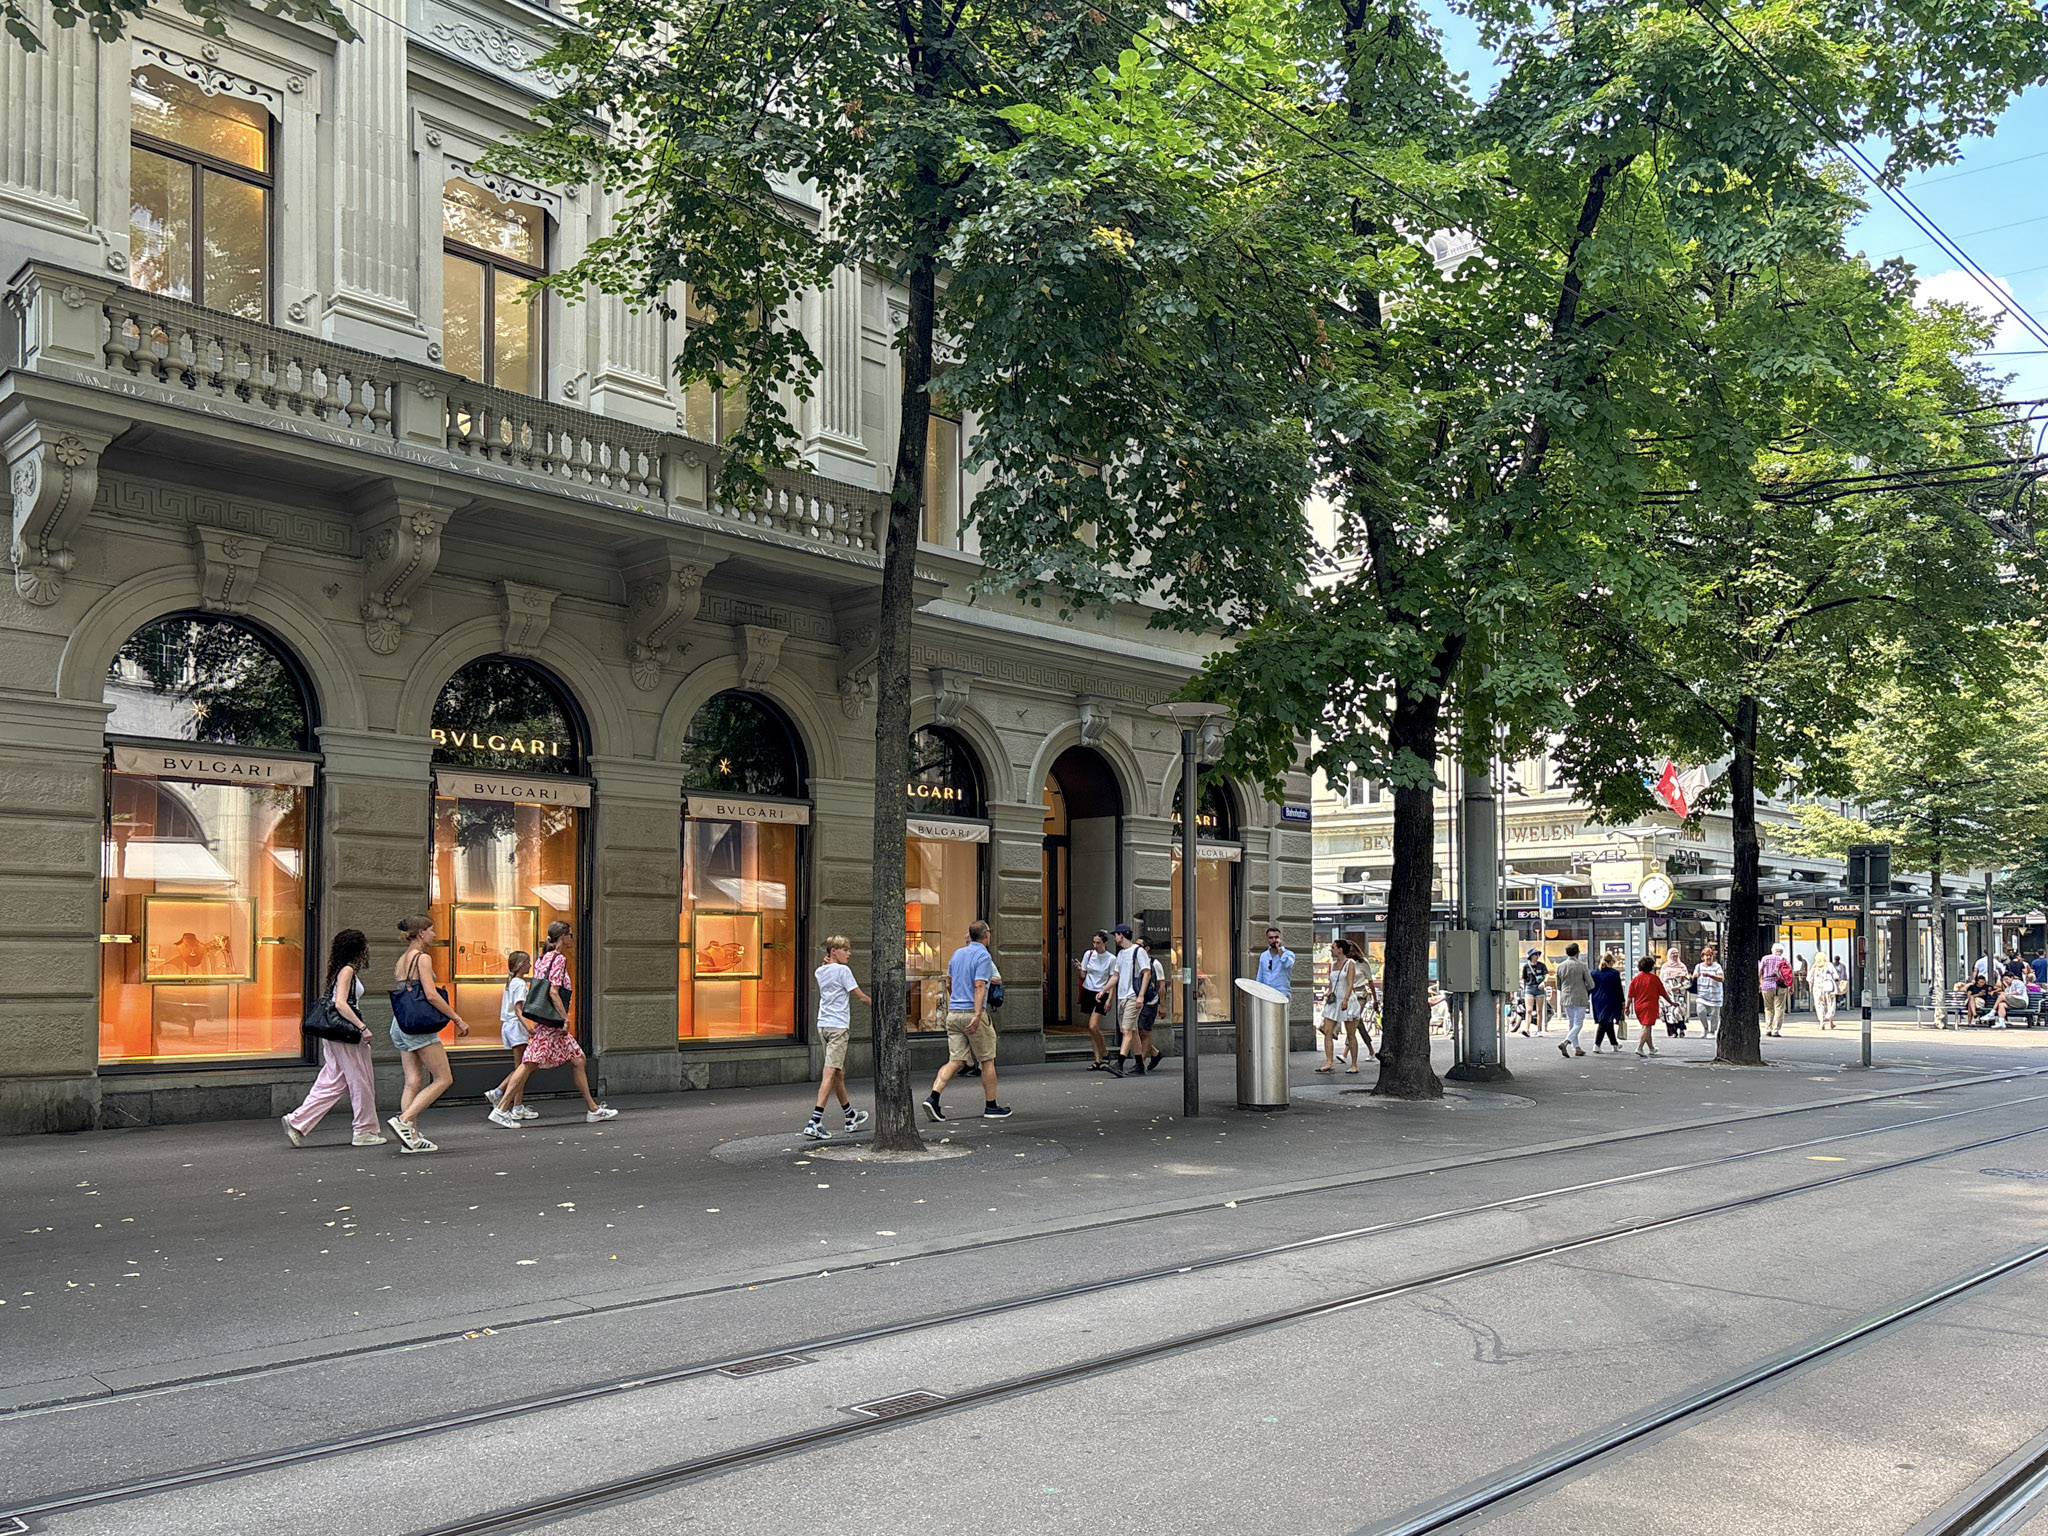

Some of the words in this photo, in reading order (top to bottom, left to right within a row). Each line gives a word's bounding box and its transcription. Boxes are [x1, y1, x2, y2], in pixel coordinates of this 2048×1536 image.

[431, 729, 557, 756] BVLGARI
[163, 758, 271, 777] BVLGARI
[474, 783, 557, 800] BVLGARI
[907, 783, 962, 800] LGARI
[717, 805, 784, 819] BVLGARI
[918, 825, 970, 837] BVLGARI
[1571, 850, 1628, 865] BEYER
